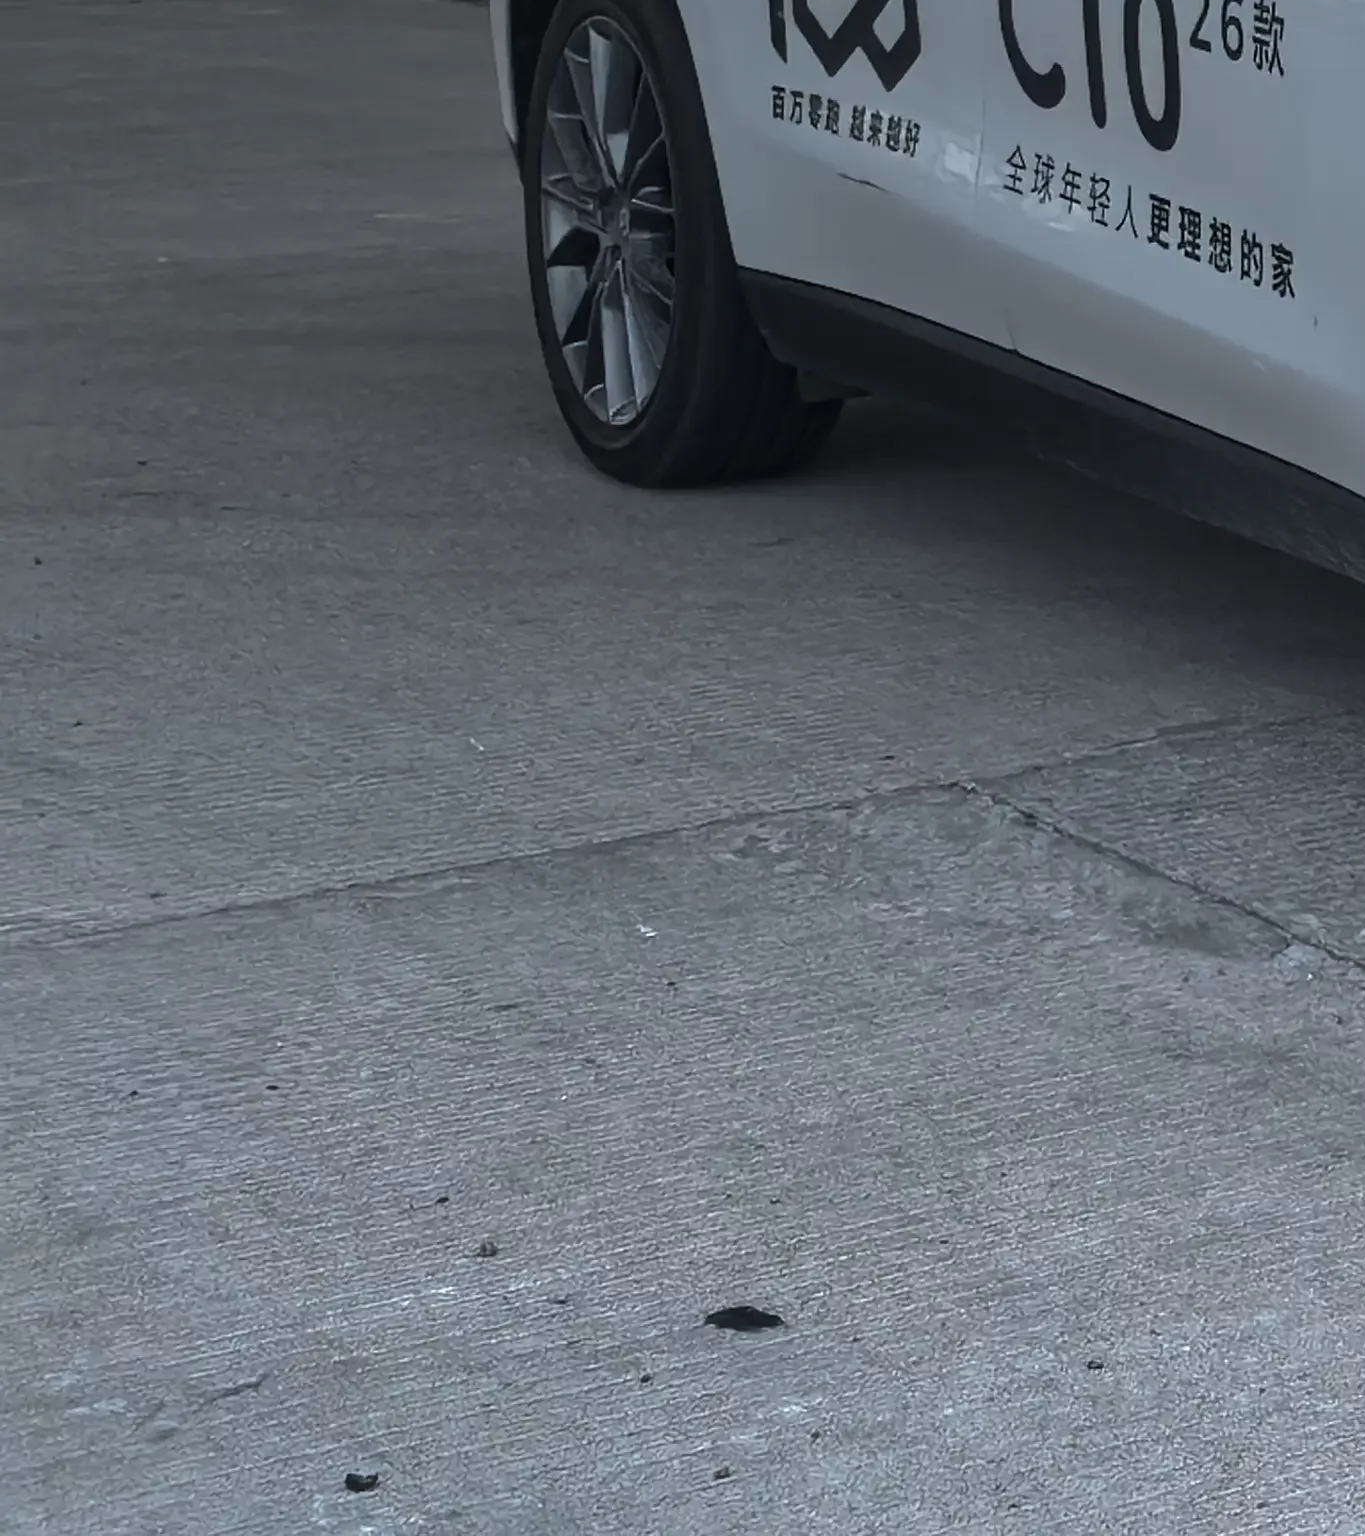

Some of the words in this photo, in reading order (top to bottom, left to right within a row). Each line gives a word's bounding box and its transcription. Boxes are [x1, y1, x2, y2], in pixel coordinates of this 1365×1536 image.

[771, 85, 840, 136] 百万零跑
[849, 105, 921, 157] 越来越好
[1003, 145, 1296, 299] 全球年轻人更理想的家
